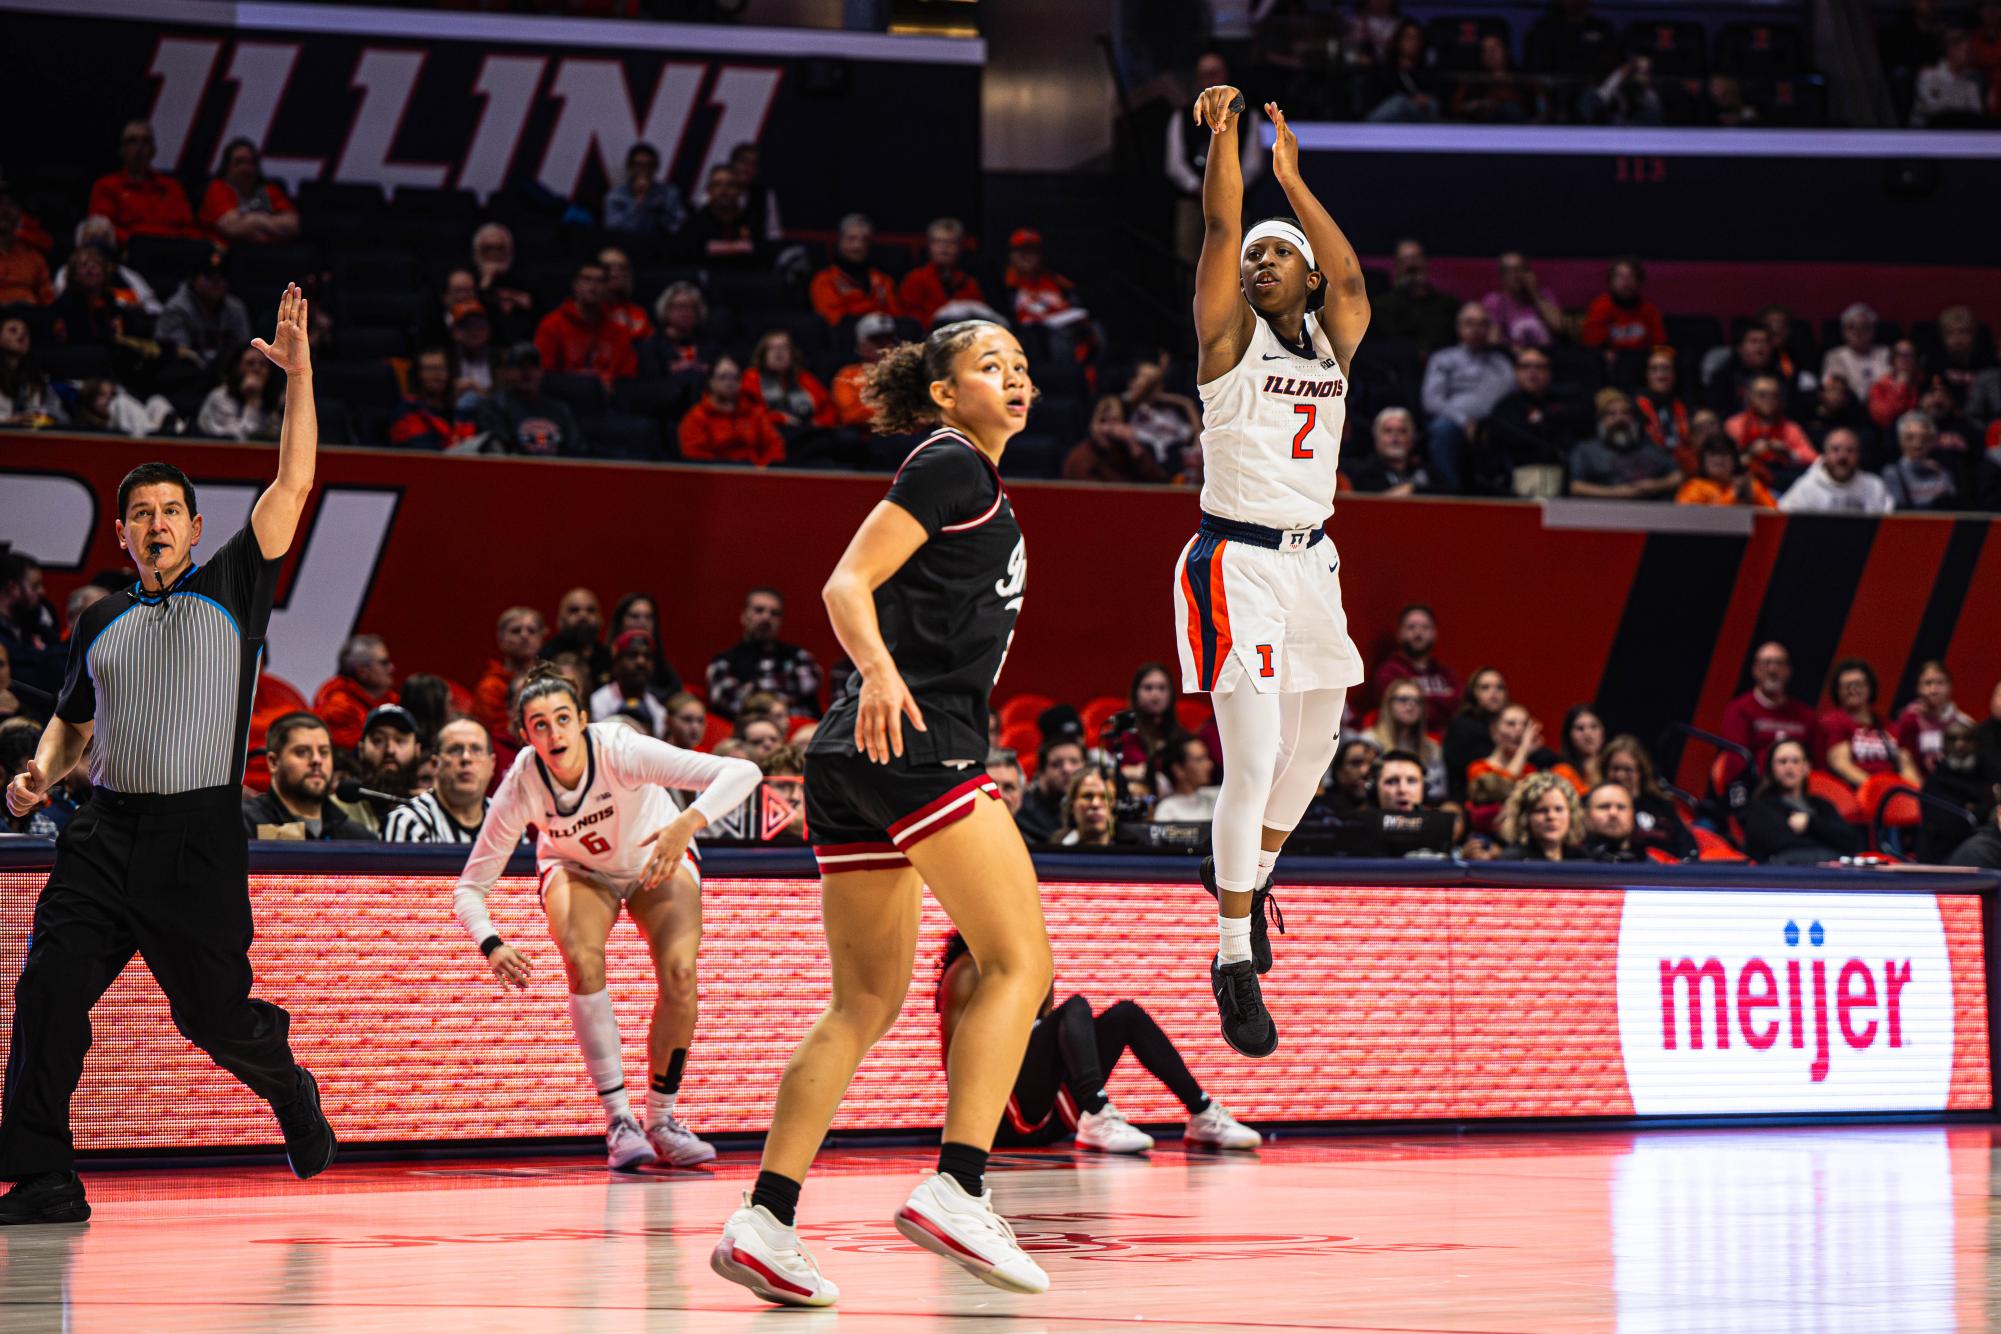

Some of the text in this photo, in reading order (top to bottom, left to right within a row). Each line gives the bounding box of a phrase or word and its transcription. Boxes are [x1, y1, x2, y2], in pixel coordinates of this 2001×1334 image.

[148, 37, 783, 205] ILLINI
[1263, 375, 1343, 398] ILLINOIS
[1292, 403, 1316, 459] 2
[548, 806, 614, 838] ILLINOIS
[579, 831, 611, 855] 6
[1659, 920, 1912, 1082] meijer
